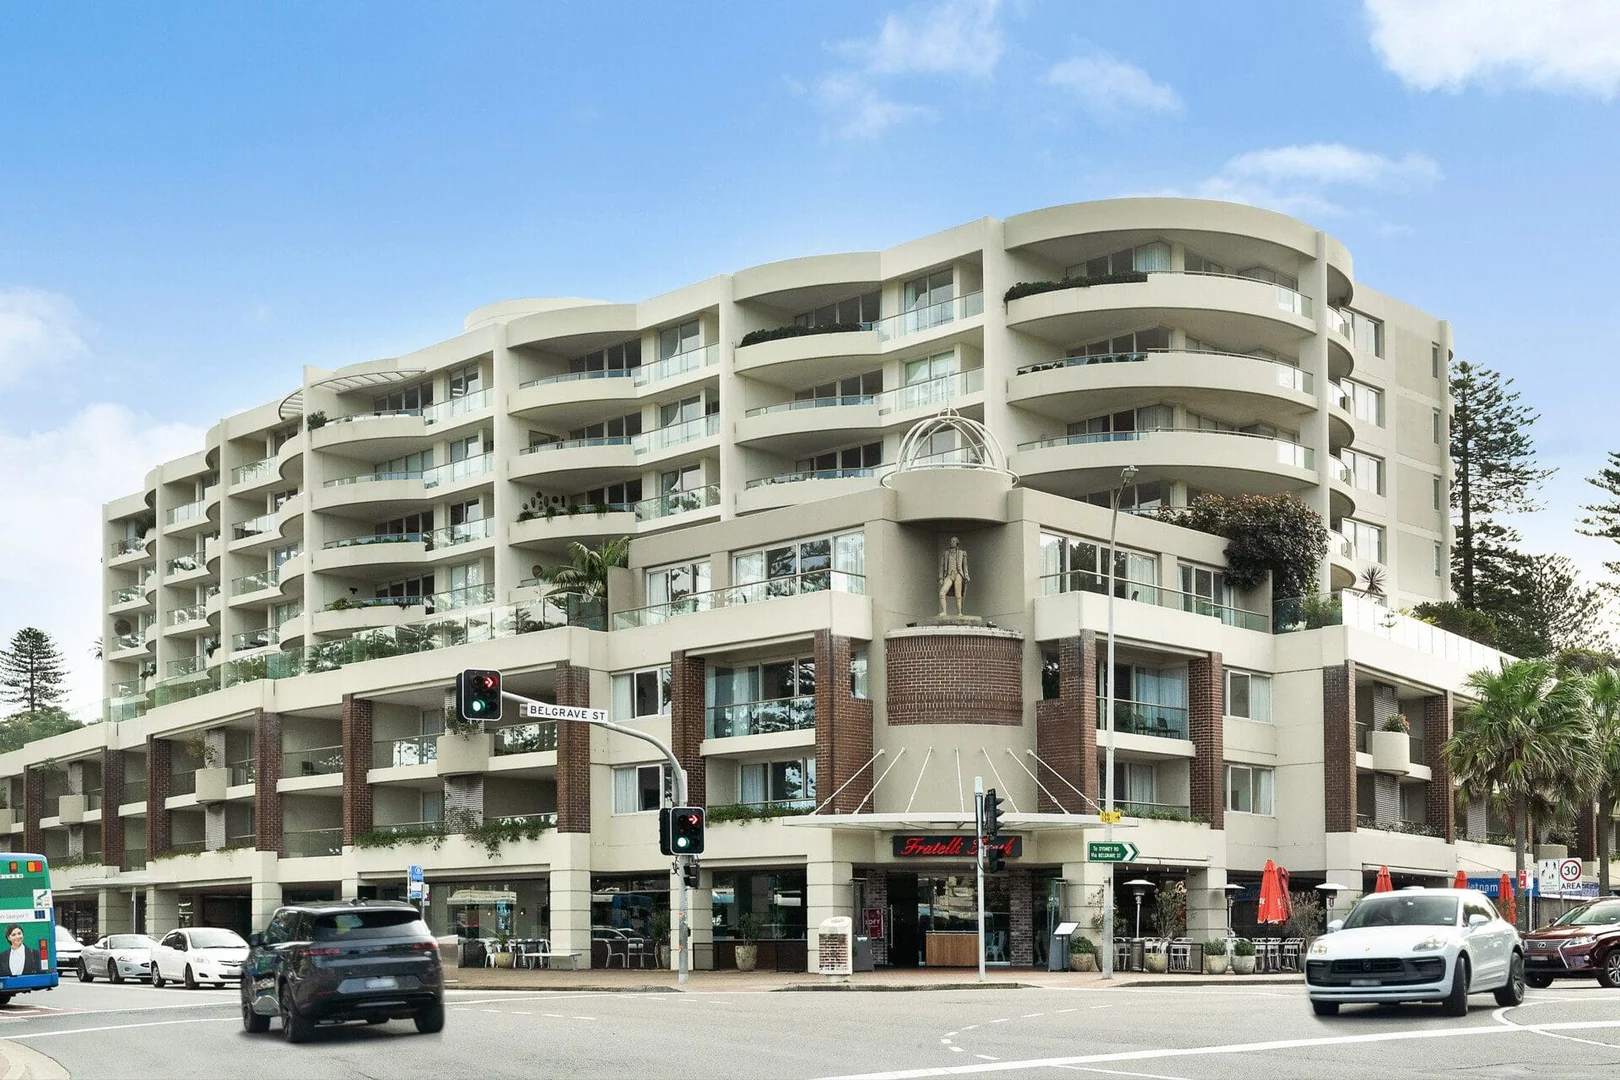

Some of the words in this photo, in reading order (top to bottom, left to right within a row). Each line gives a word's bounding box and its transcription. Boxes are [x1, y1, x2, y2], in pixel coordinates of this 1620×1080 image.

[530, 705, 588, 719] BELGRAVE
[592, 711, 605, 720] ST
[900, 836, 964, 855] Fratelli
[1564, 866, 1578, 876] 30
[1467, 882, 1498, 892] ietnam
